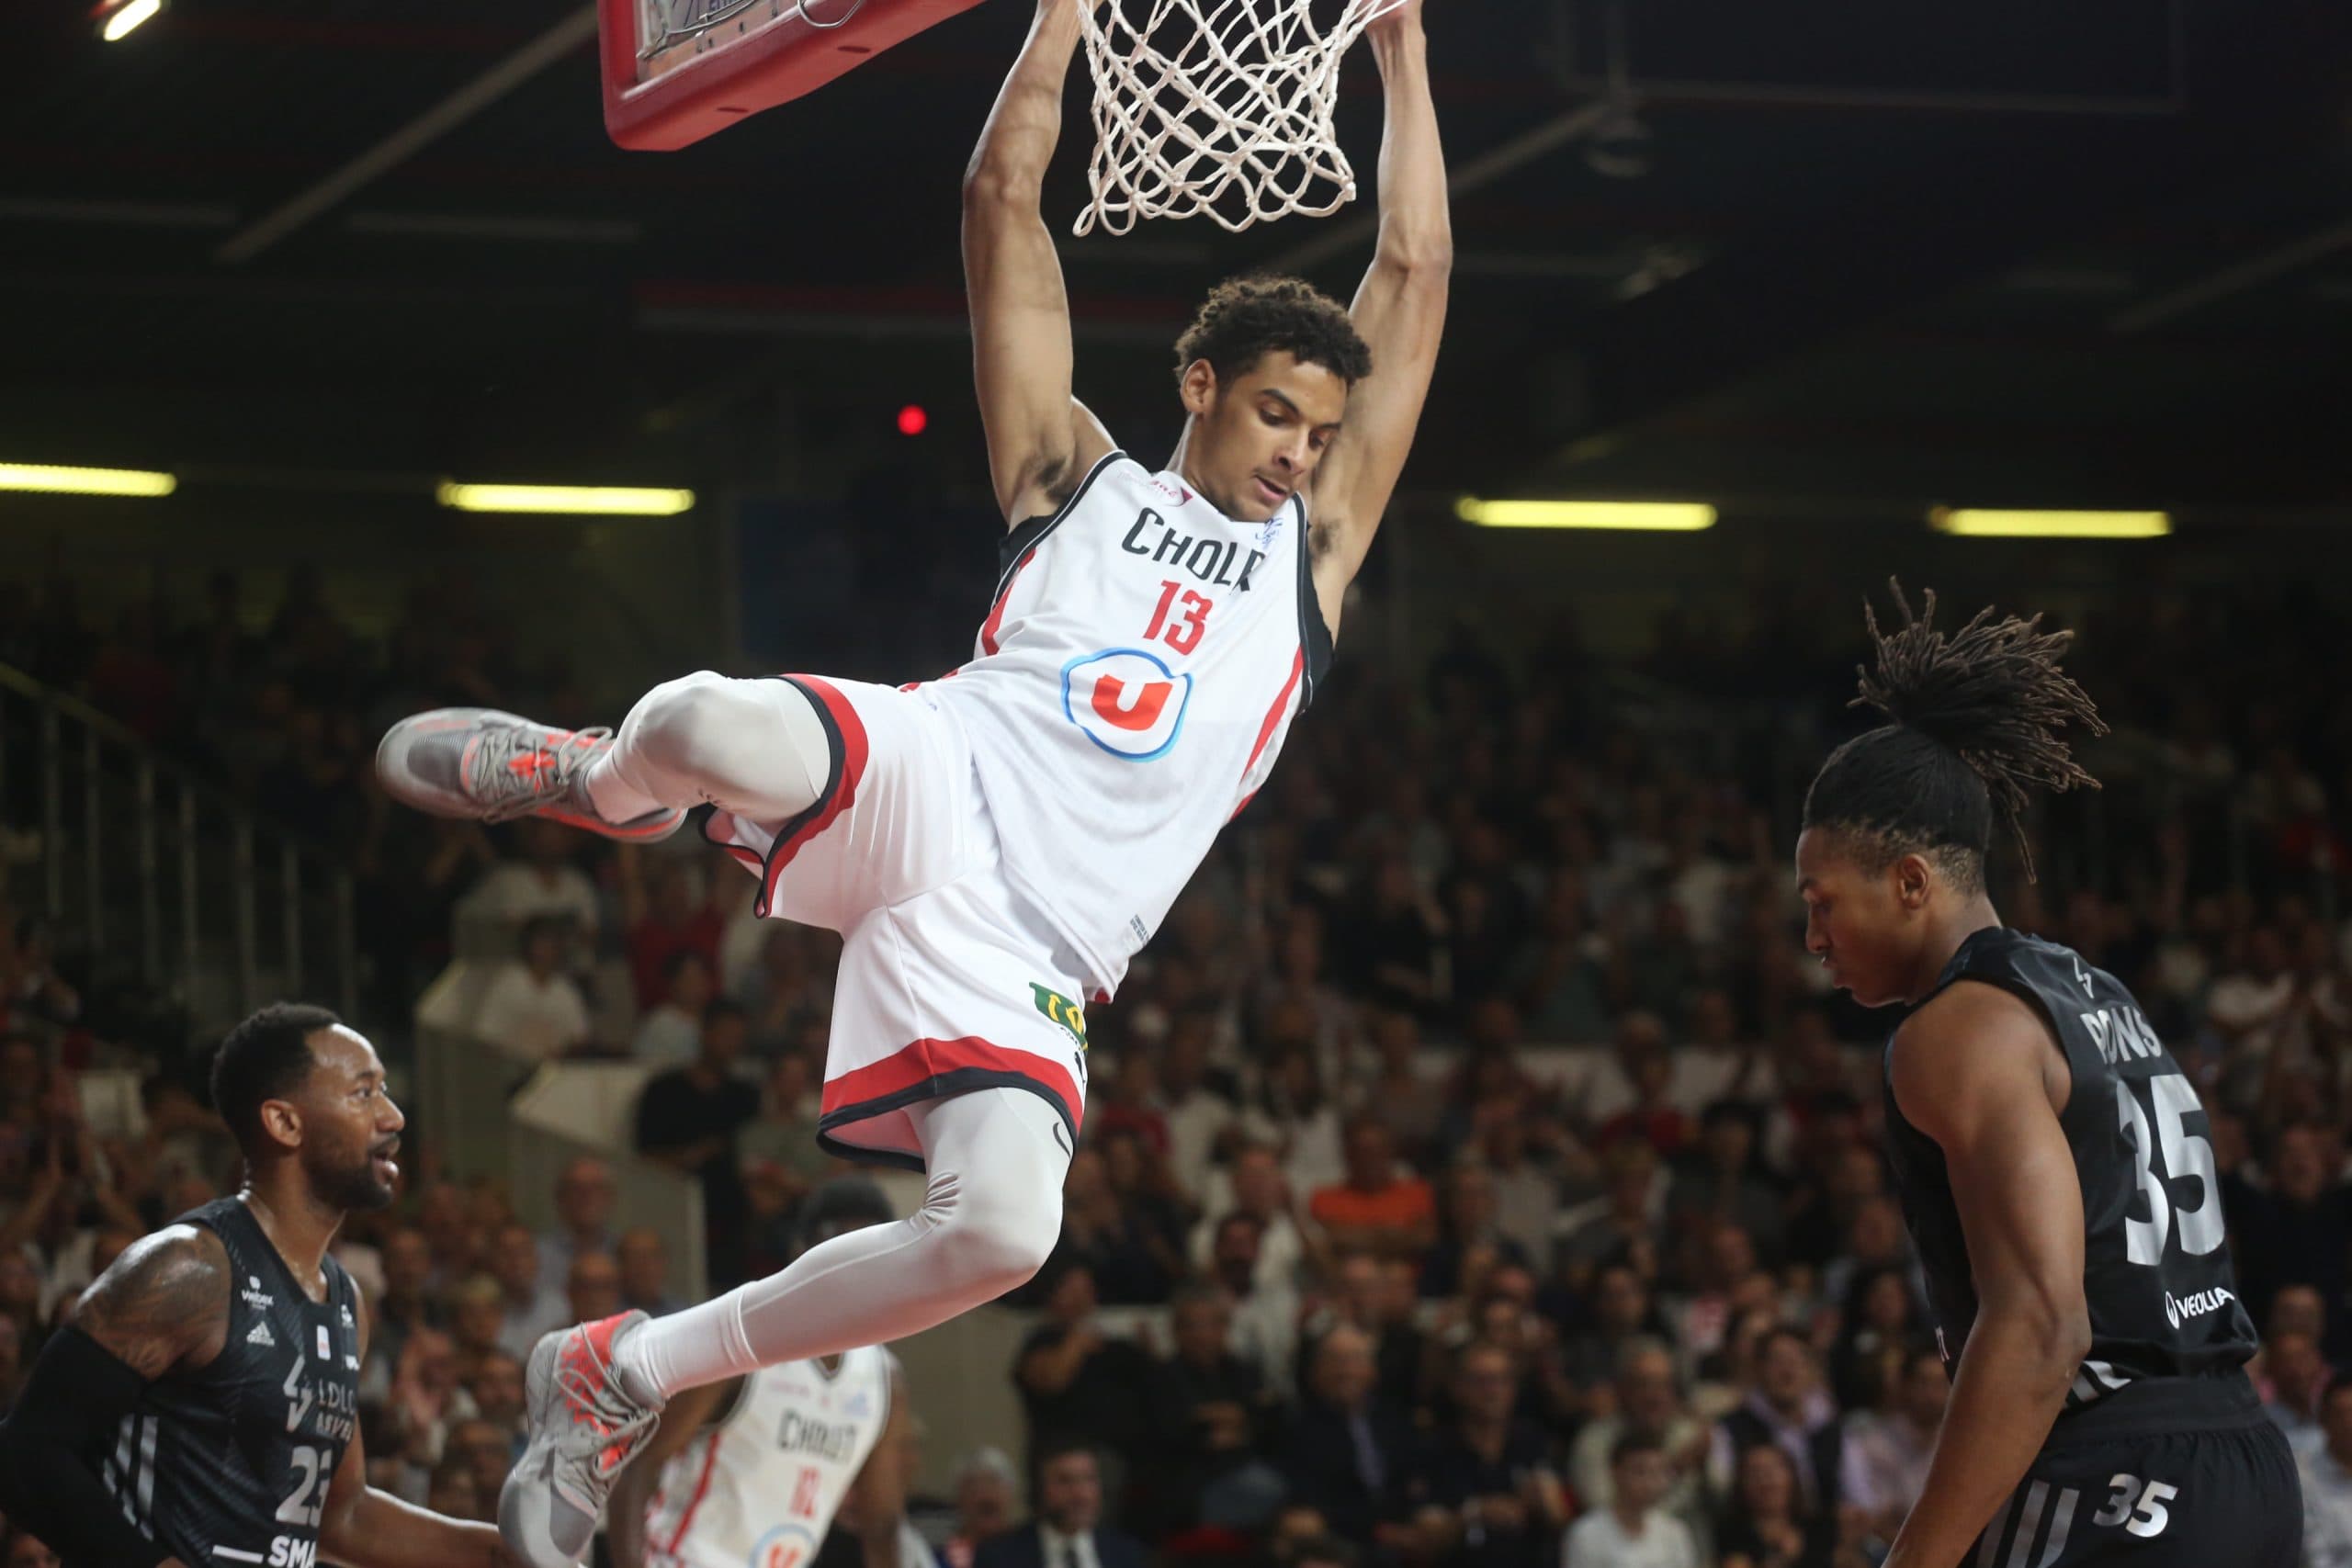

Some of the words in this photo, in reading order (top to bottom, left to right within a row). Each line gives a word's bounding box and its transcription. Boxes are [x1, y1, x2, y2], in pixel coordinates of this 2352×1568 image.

[1143, 581, 1214, 656] 13
[1091, 674, 1173, 731] U
[2080, 1006, 2162, 1065] PONS
[2116, 1073, 2225, 1267] 35
[2175, 1286, 2235, 1319] VEOLIA
[2092, 1472, 2179, 1538] 35
